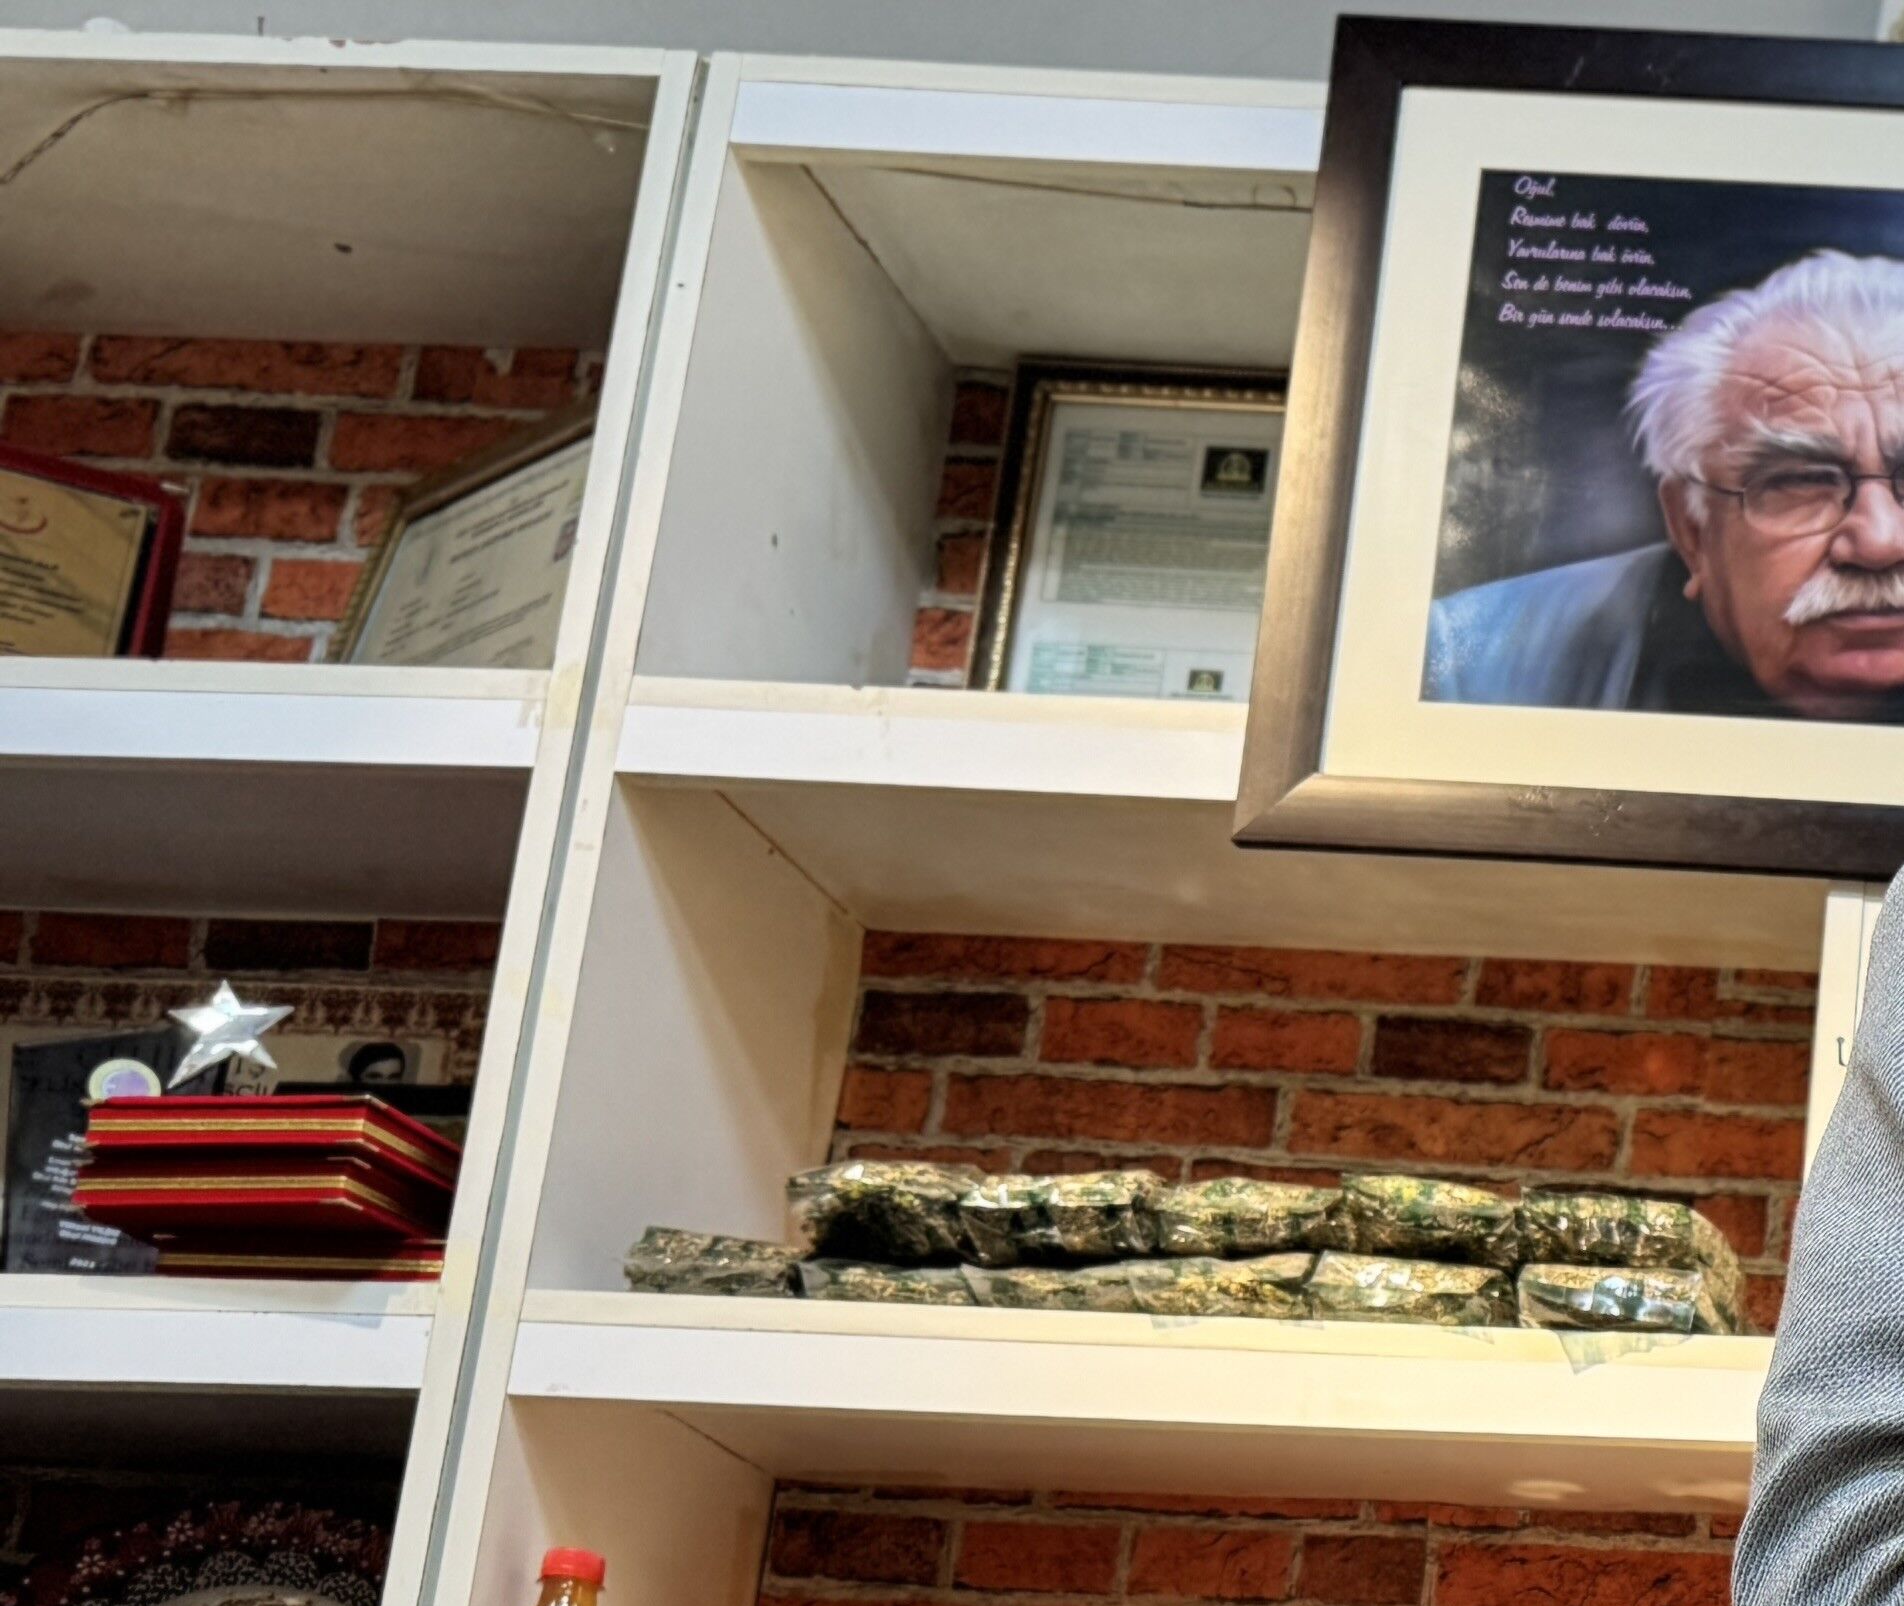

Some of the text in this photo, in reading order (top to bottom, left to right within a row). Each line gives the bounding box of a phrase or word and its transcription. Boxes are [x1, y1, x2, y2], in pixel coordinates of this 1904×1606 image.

[1571, 211, 1595, 229] bak
[1591, 245, 1616, 262] bak
[1501, 270, 1528, 290] Sen
[1533, 275, 1549, 291] de
[1554, 275, 1592, 292] benim
[1595, 278, 1622, 299] gibi
[1499, 303, 1523, 322] Bir
[1528, 309, 1553, 328] gün
[1558, 309, 1593, 326] sende
